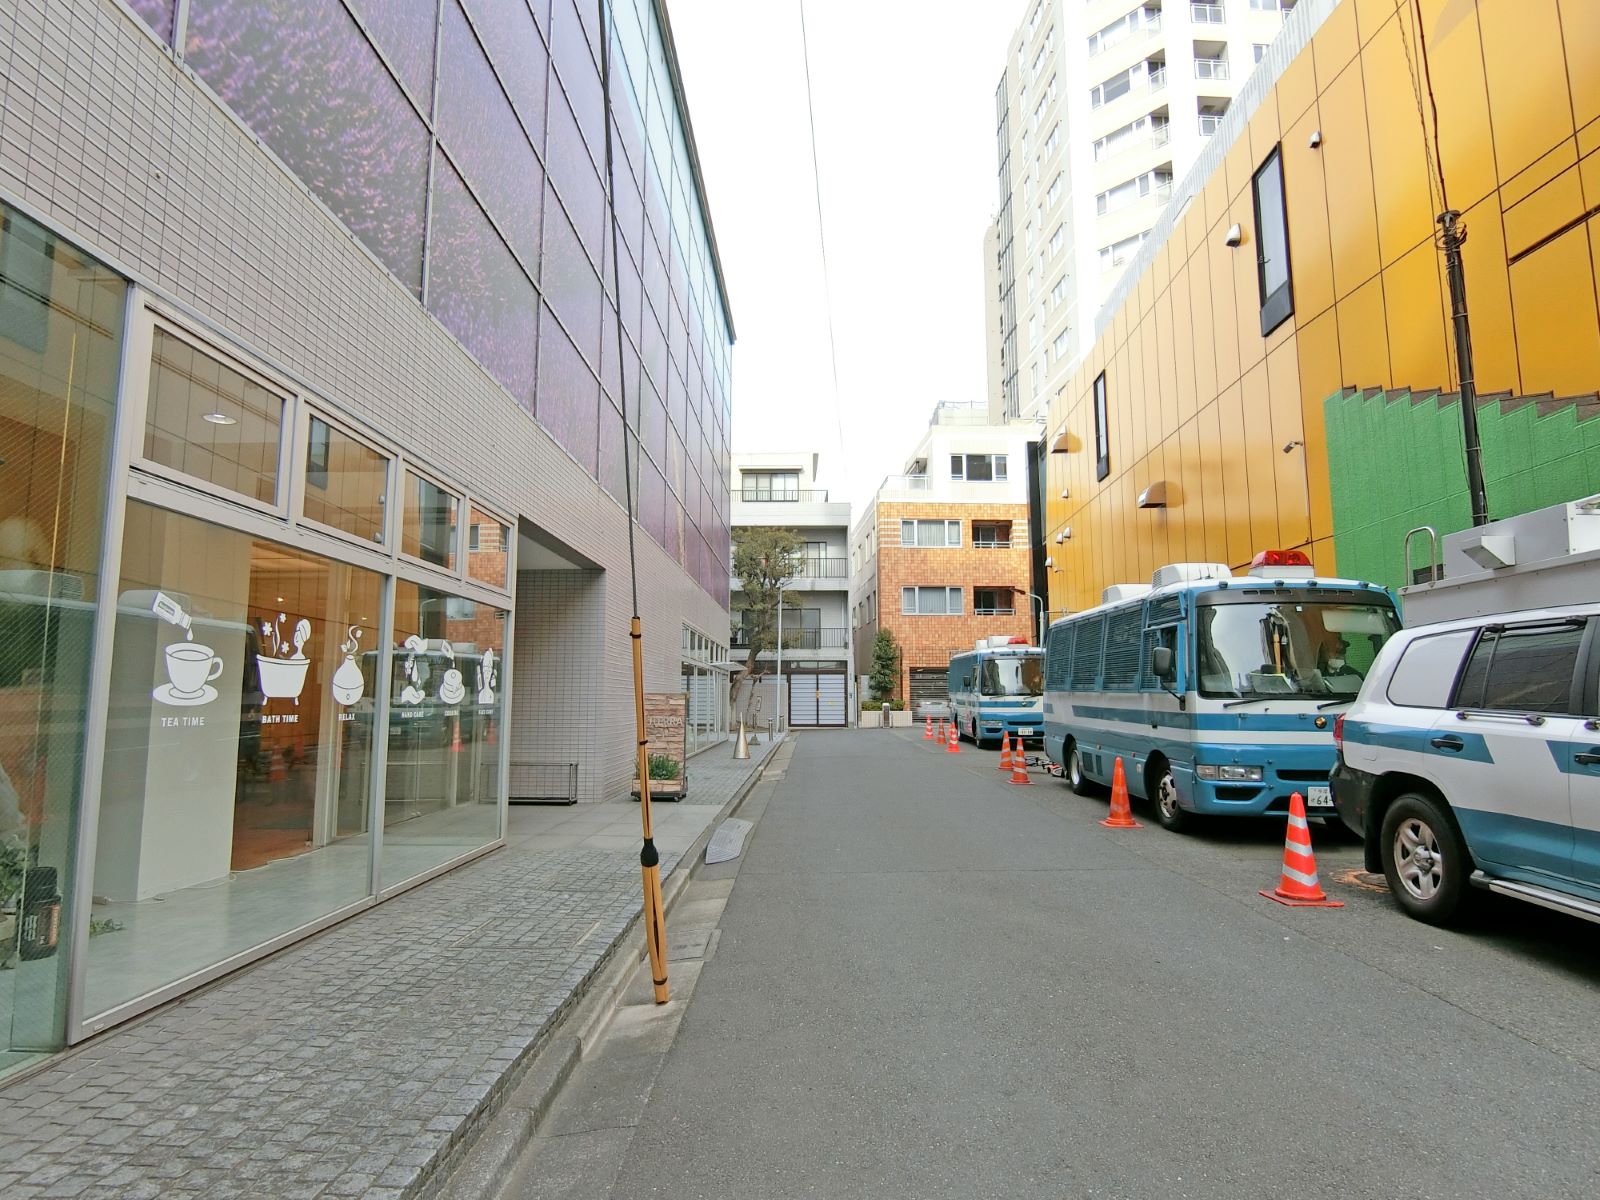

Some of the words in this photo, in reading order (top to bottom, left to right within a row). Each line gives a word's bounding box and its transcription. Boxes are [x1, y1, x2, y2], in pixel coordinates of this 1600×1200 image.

[161, 717, 179, 727] TEA
[182, 716, 206, 727] TIME
[261, 715, 281, 724] BATH
[282, 714, 299, 723] TIME
[338, 713, 356, 721] RELAX
